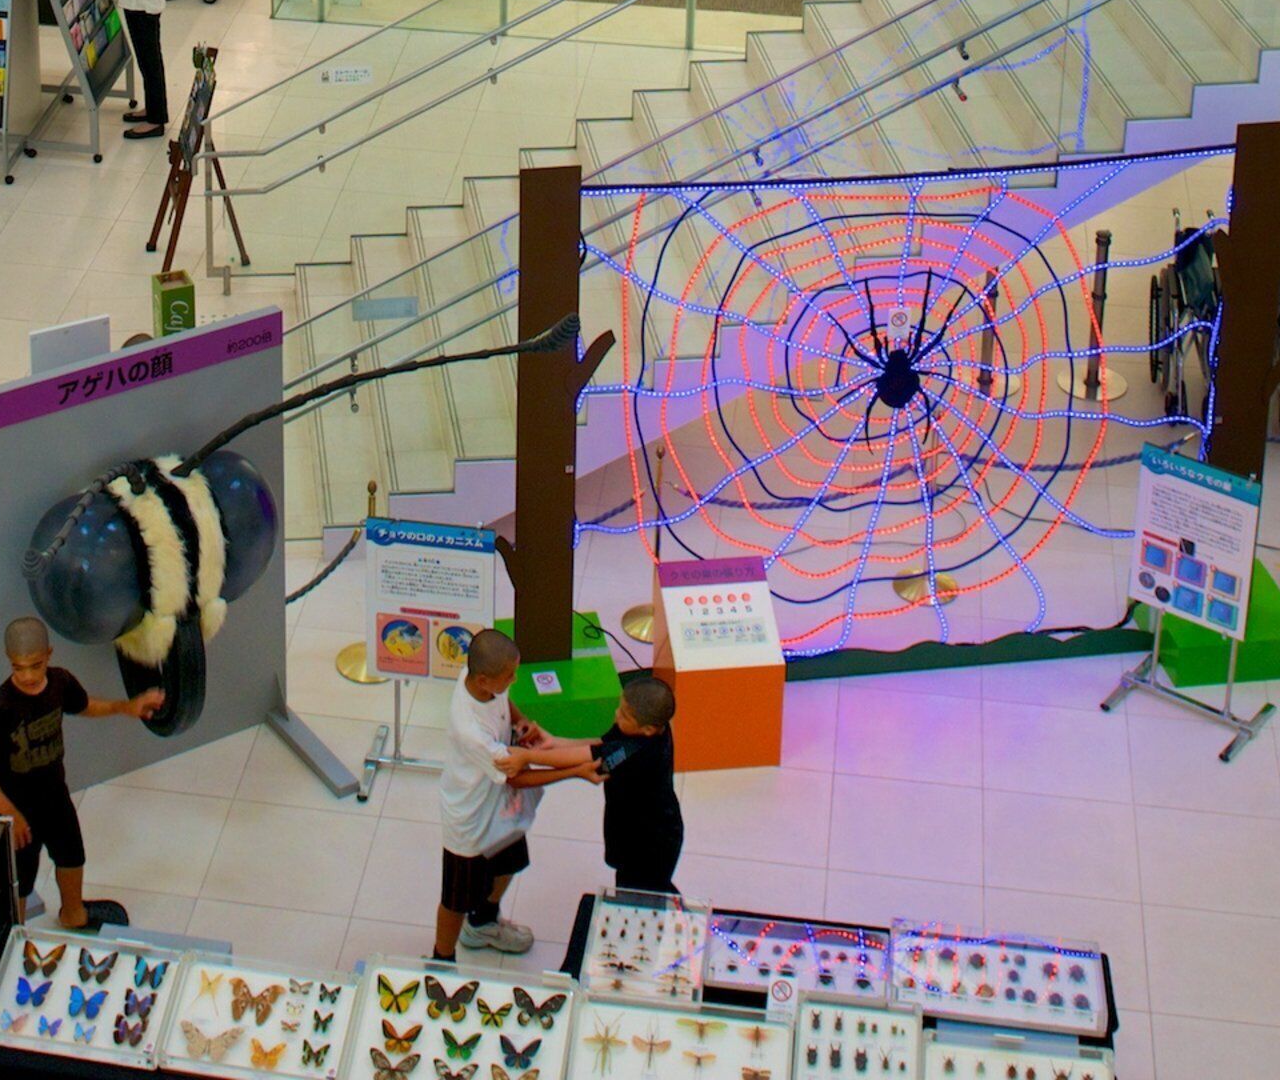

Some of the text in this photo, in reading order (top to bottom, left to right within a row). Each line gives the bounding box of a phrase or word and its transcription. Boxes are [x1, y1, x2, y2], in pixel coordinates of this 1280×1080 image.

[57, 329, 273, 406] アゲハの顔 約200倍
[378, 528, 484, 548] チョウの口のメカニズム
